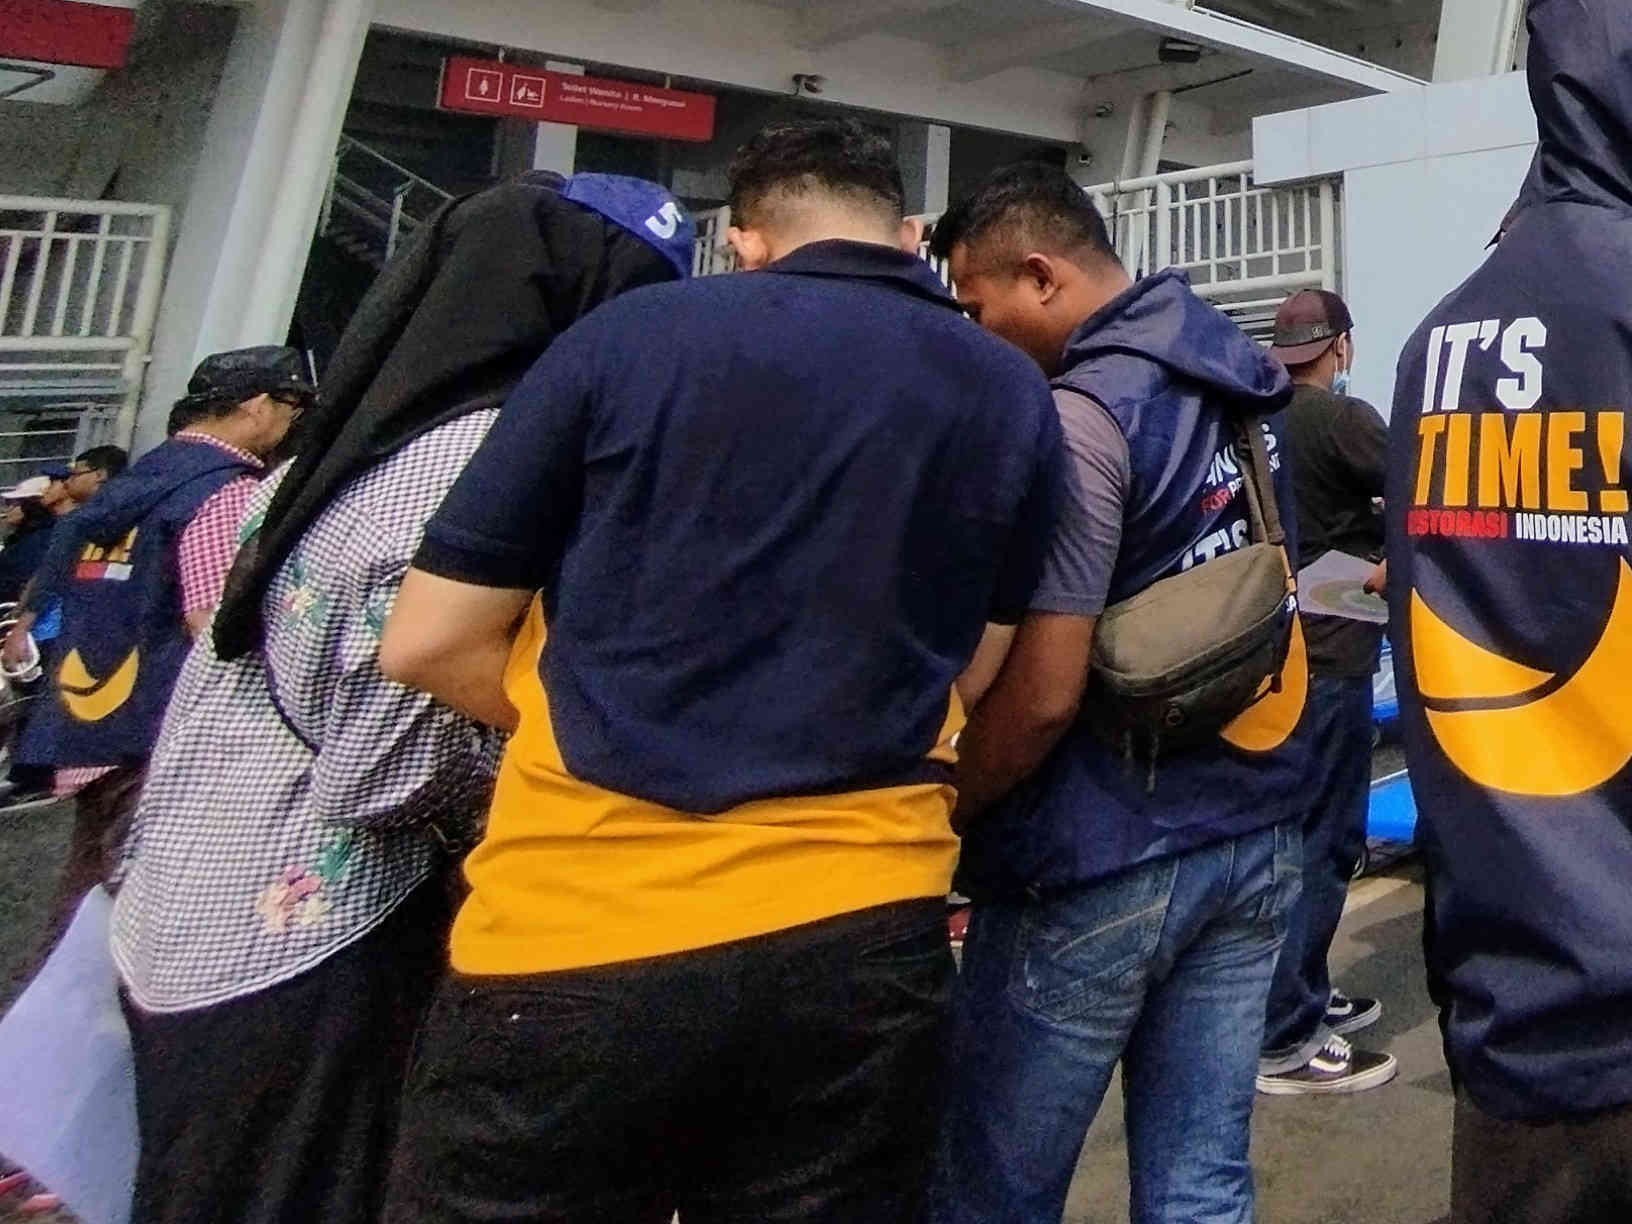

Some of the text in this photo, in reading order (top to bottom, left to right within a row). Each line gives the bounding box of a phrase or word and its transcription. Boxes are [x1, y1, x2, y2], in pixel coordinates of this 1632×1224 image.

[1421, 316, 1547, 414] IT'S
[1414, 411, 1629, 512] TIME!
[1515, 511, 1629, 545] INDONESIA
